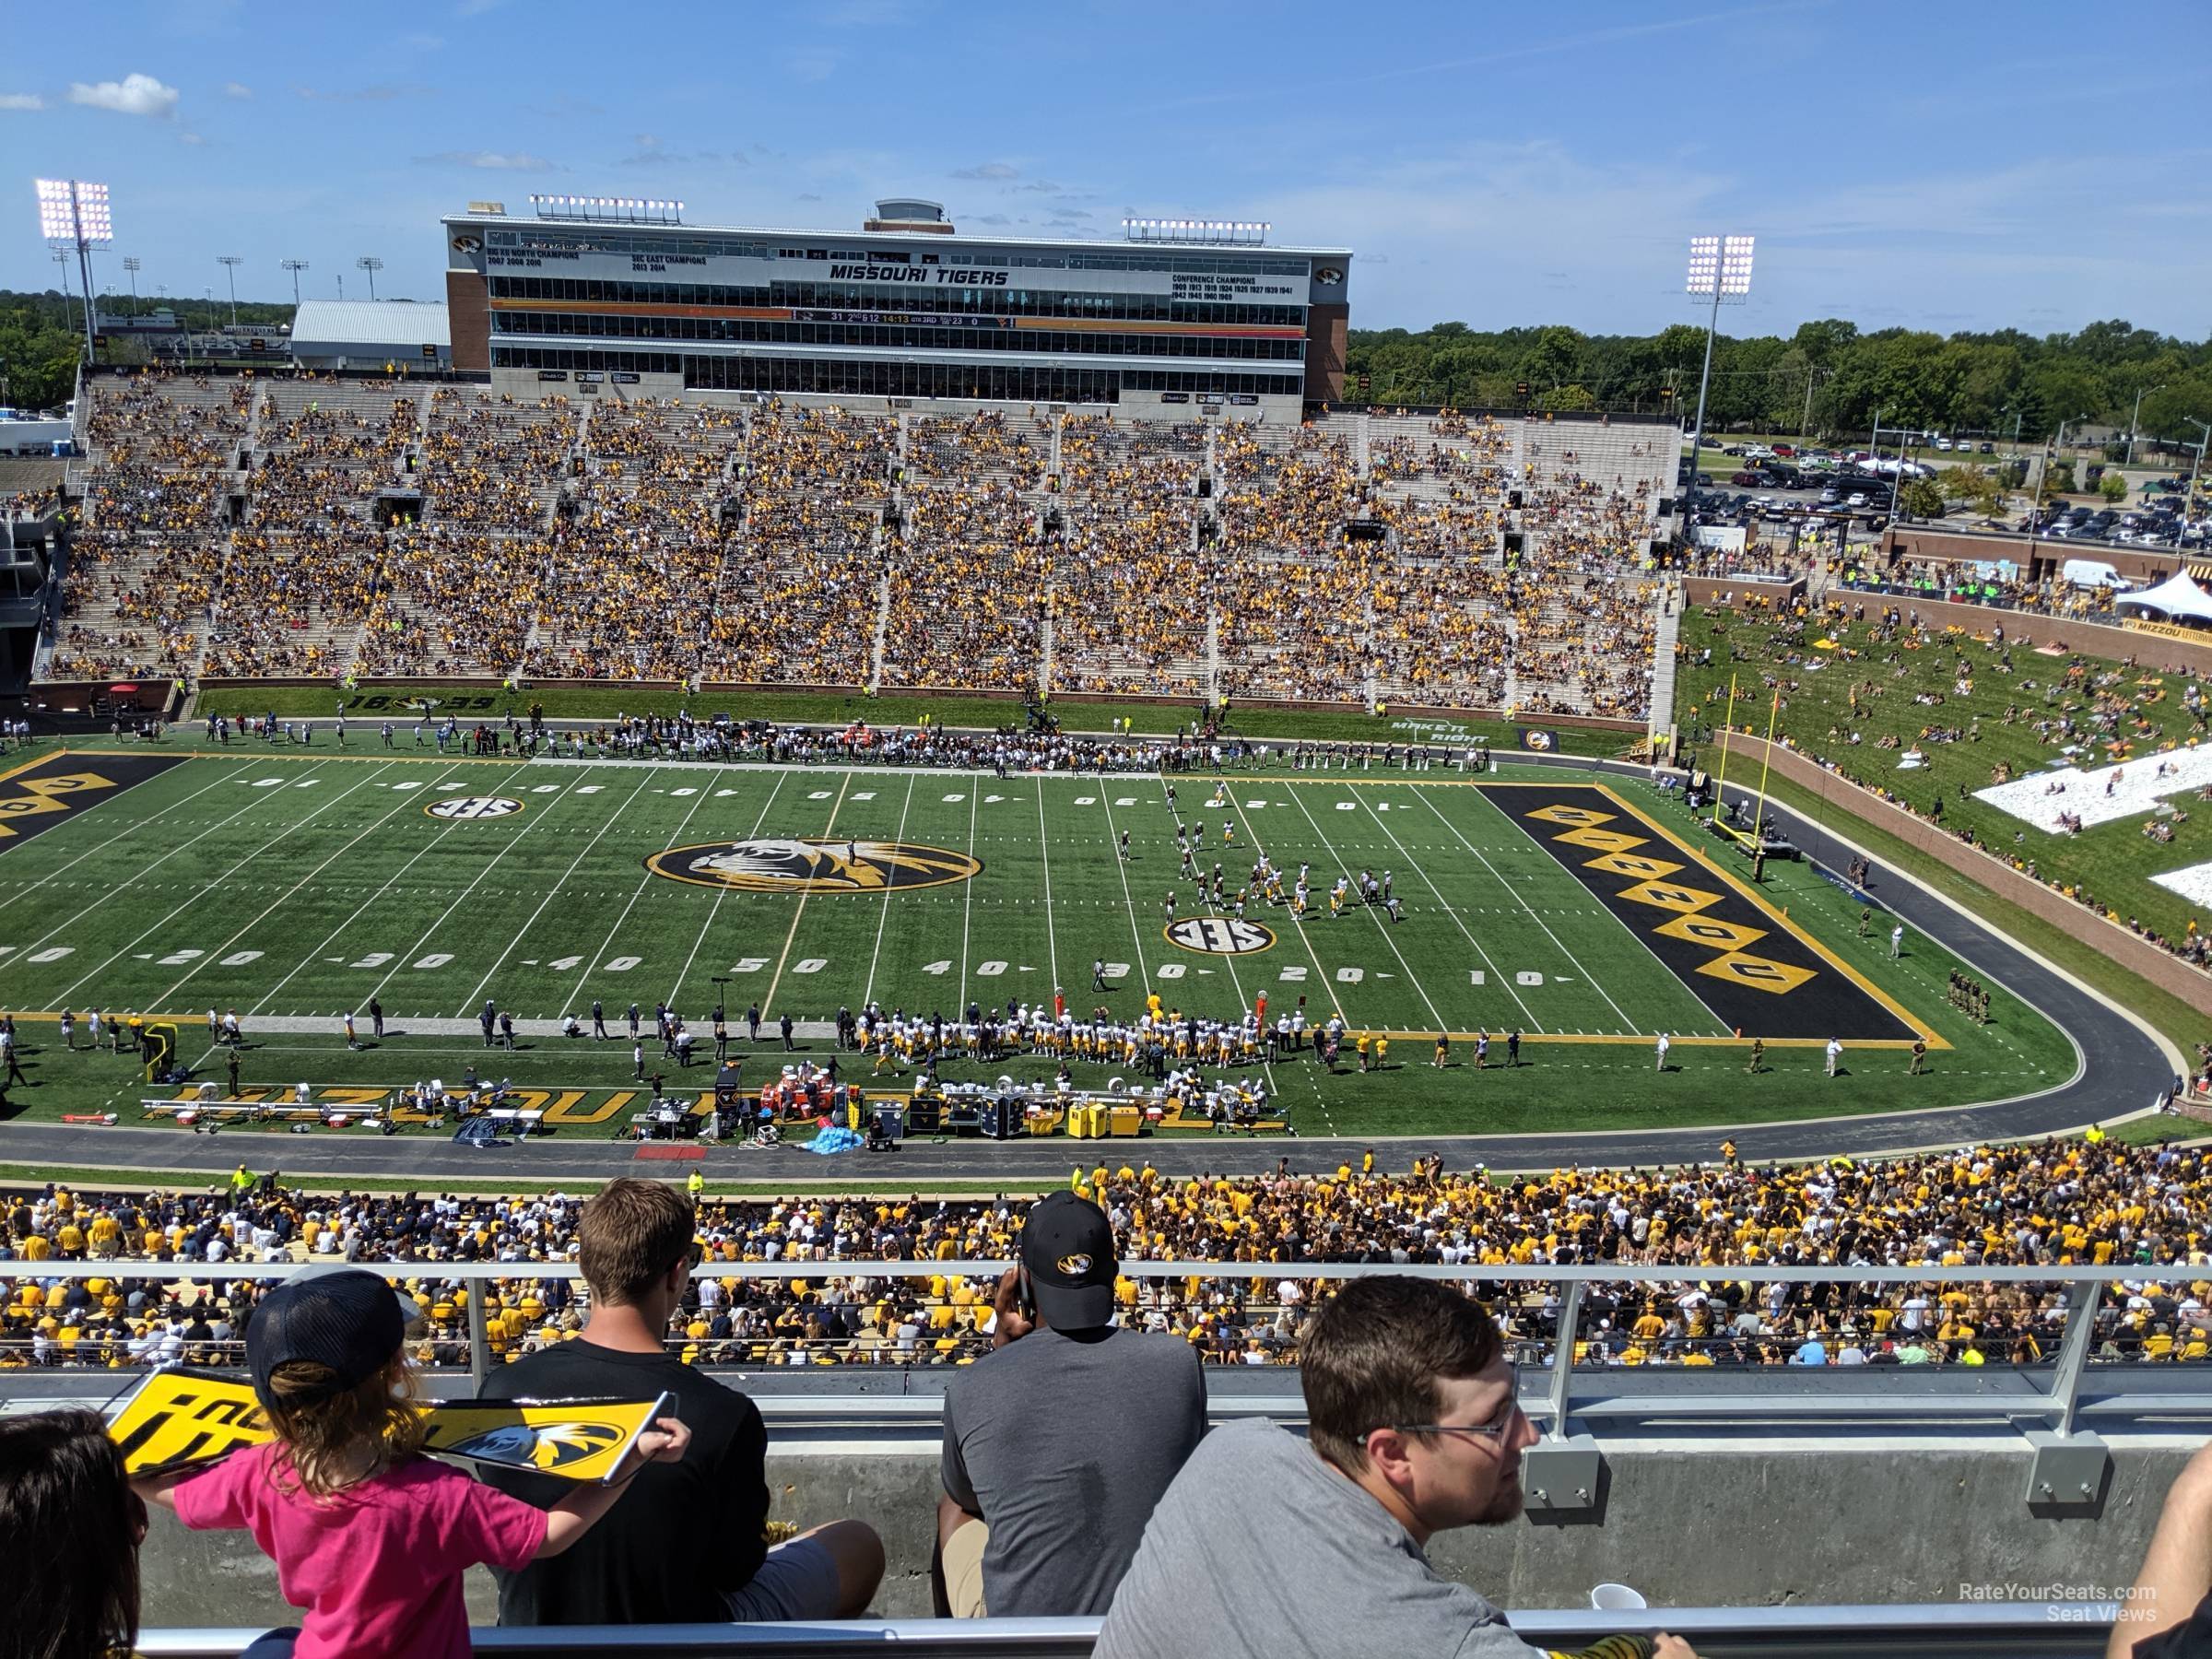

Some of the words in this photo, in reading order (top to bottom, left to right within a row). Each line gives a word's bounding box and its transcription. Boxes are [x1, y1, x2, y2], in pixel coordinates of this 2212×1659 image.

[511, 249, 535, 258] NORTH
[536, 251, 580, 260] CHAMPIONS
[632, 254, 645, 263] SEC
[665, 255, 707, 265] CHAMPIONS
[830, 265, 928, 282] MISSOURI
[936, 269, 1009, 285] TIGERS
[1172, 275, 1215, 284] CONFERENCE
[1217, 276, 1256, 285] CHAMPIONS
[831, 312, 843, 321] 31
[869, 314, 880, 323] 12
[882, 314, 910, 324] 14:13
[952, 317, 963, 325] 23
[2137, 622, 2181, 637] MIZZOU
[1430, 734, 1489, 742] RIGHT
